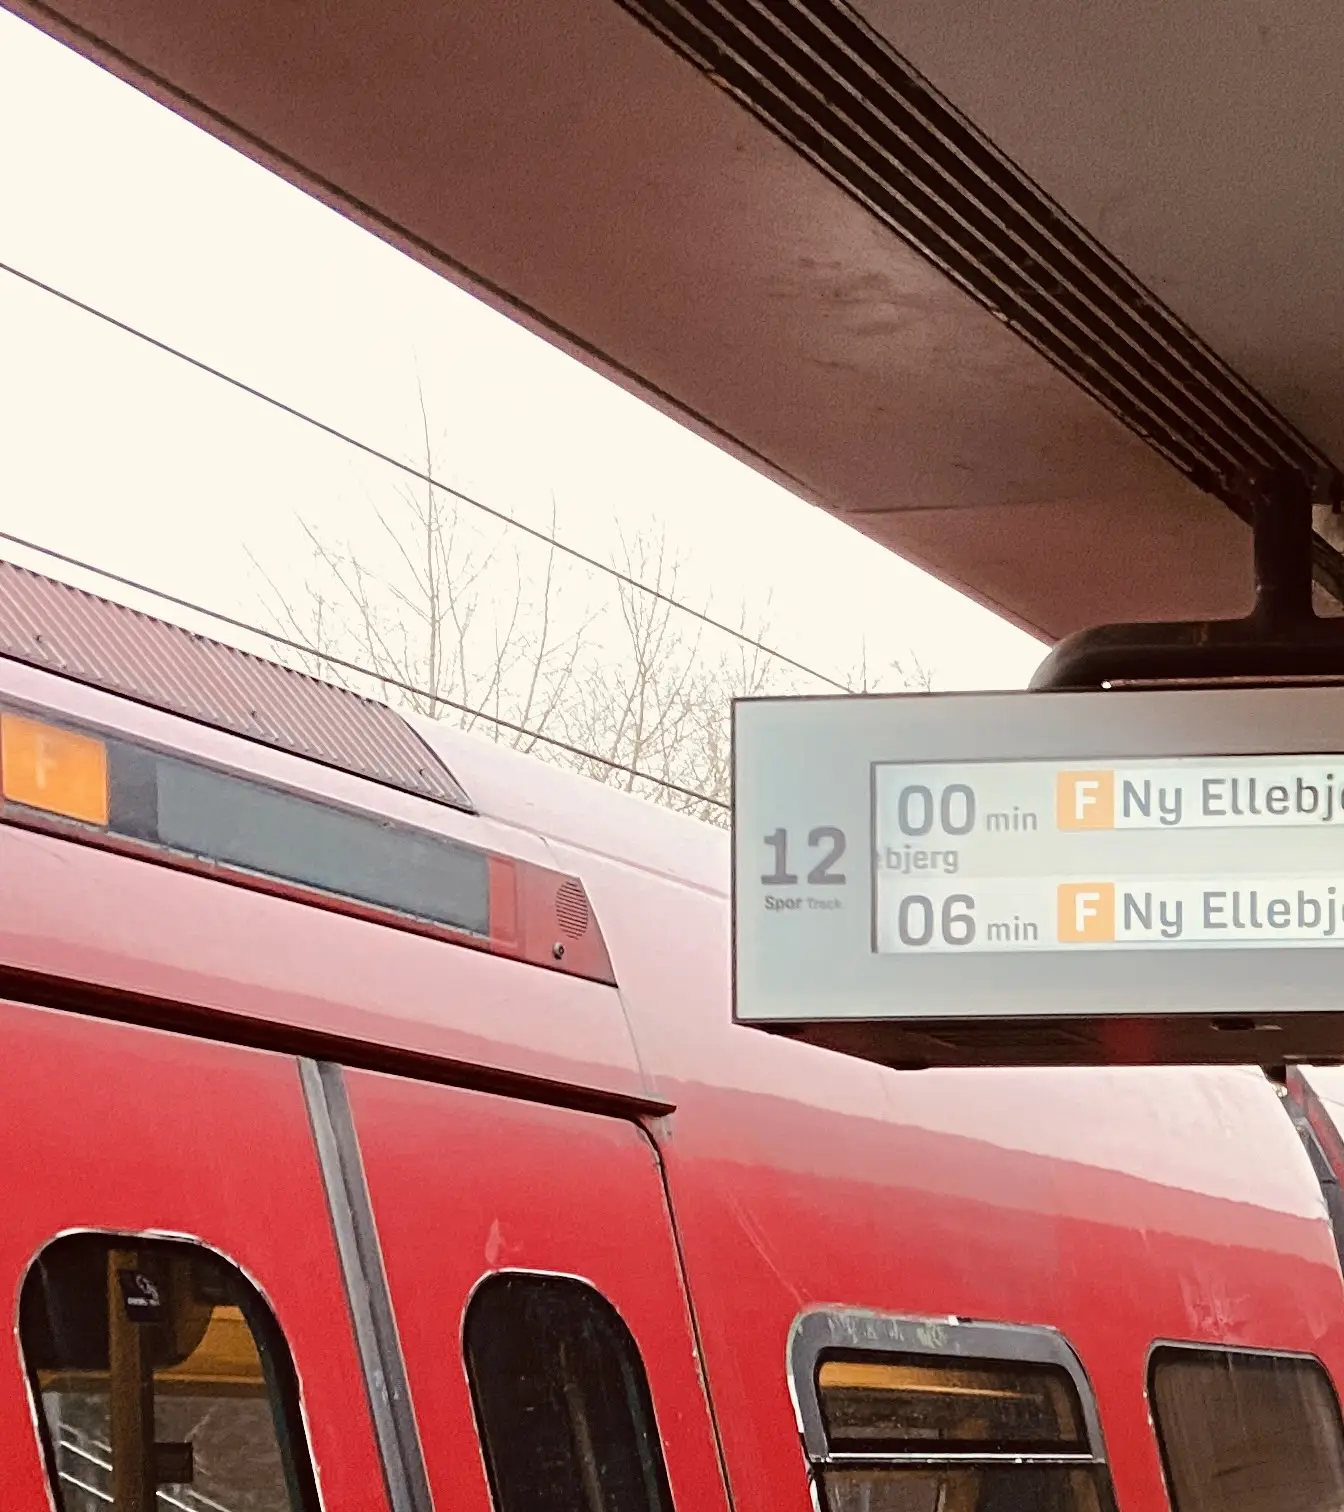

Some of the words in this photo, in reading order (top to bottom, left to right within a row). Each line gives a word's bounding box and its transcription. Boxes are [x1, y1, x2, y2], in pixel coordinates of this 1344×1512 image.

[897, 783, 976, 836] 00
[986, 806, 1038, 832] min
[1075, 780, 1099, 820] F
[1122, 779, 1182, 825] Ny
[760, 826, 847, 886] 12
[764, 895, 803, 912] Spor
[897, 893, 976, 947] 06
[987, 916, 1039, 942] min
[1075, 892, 1099, 932] F
[1123, 891, 1183, 938] Ny
